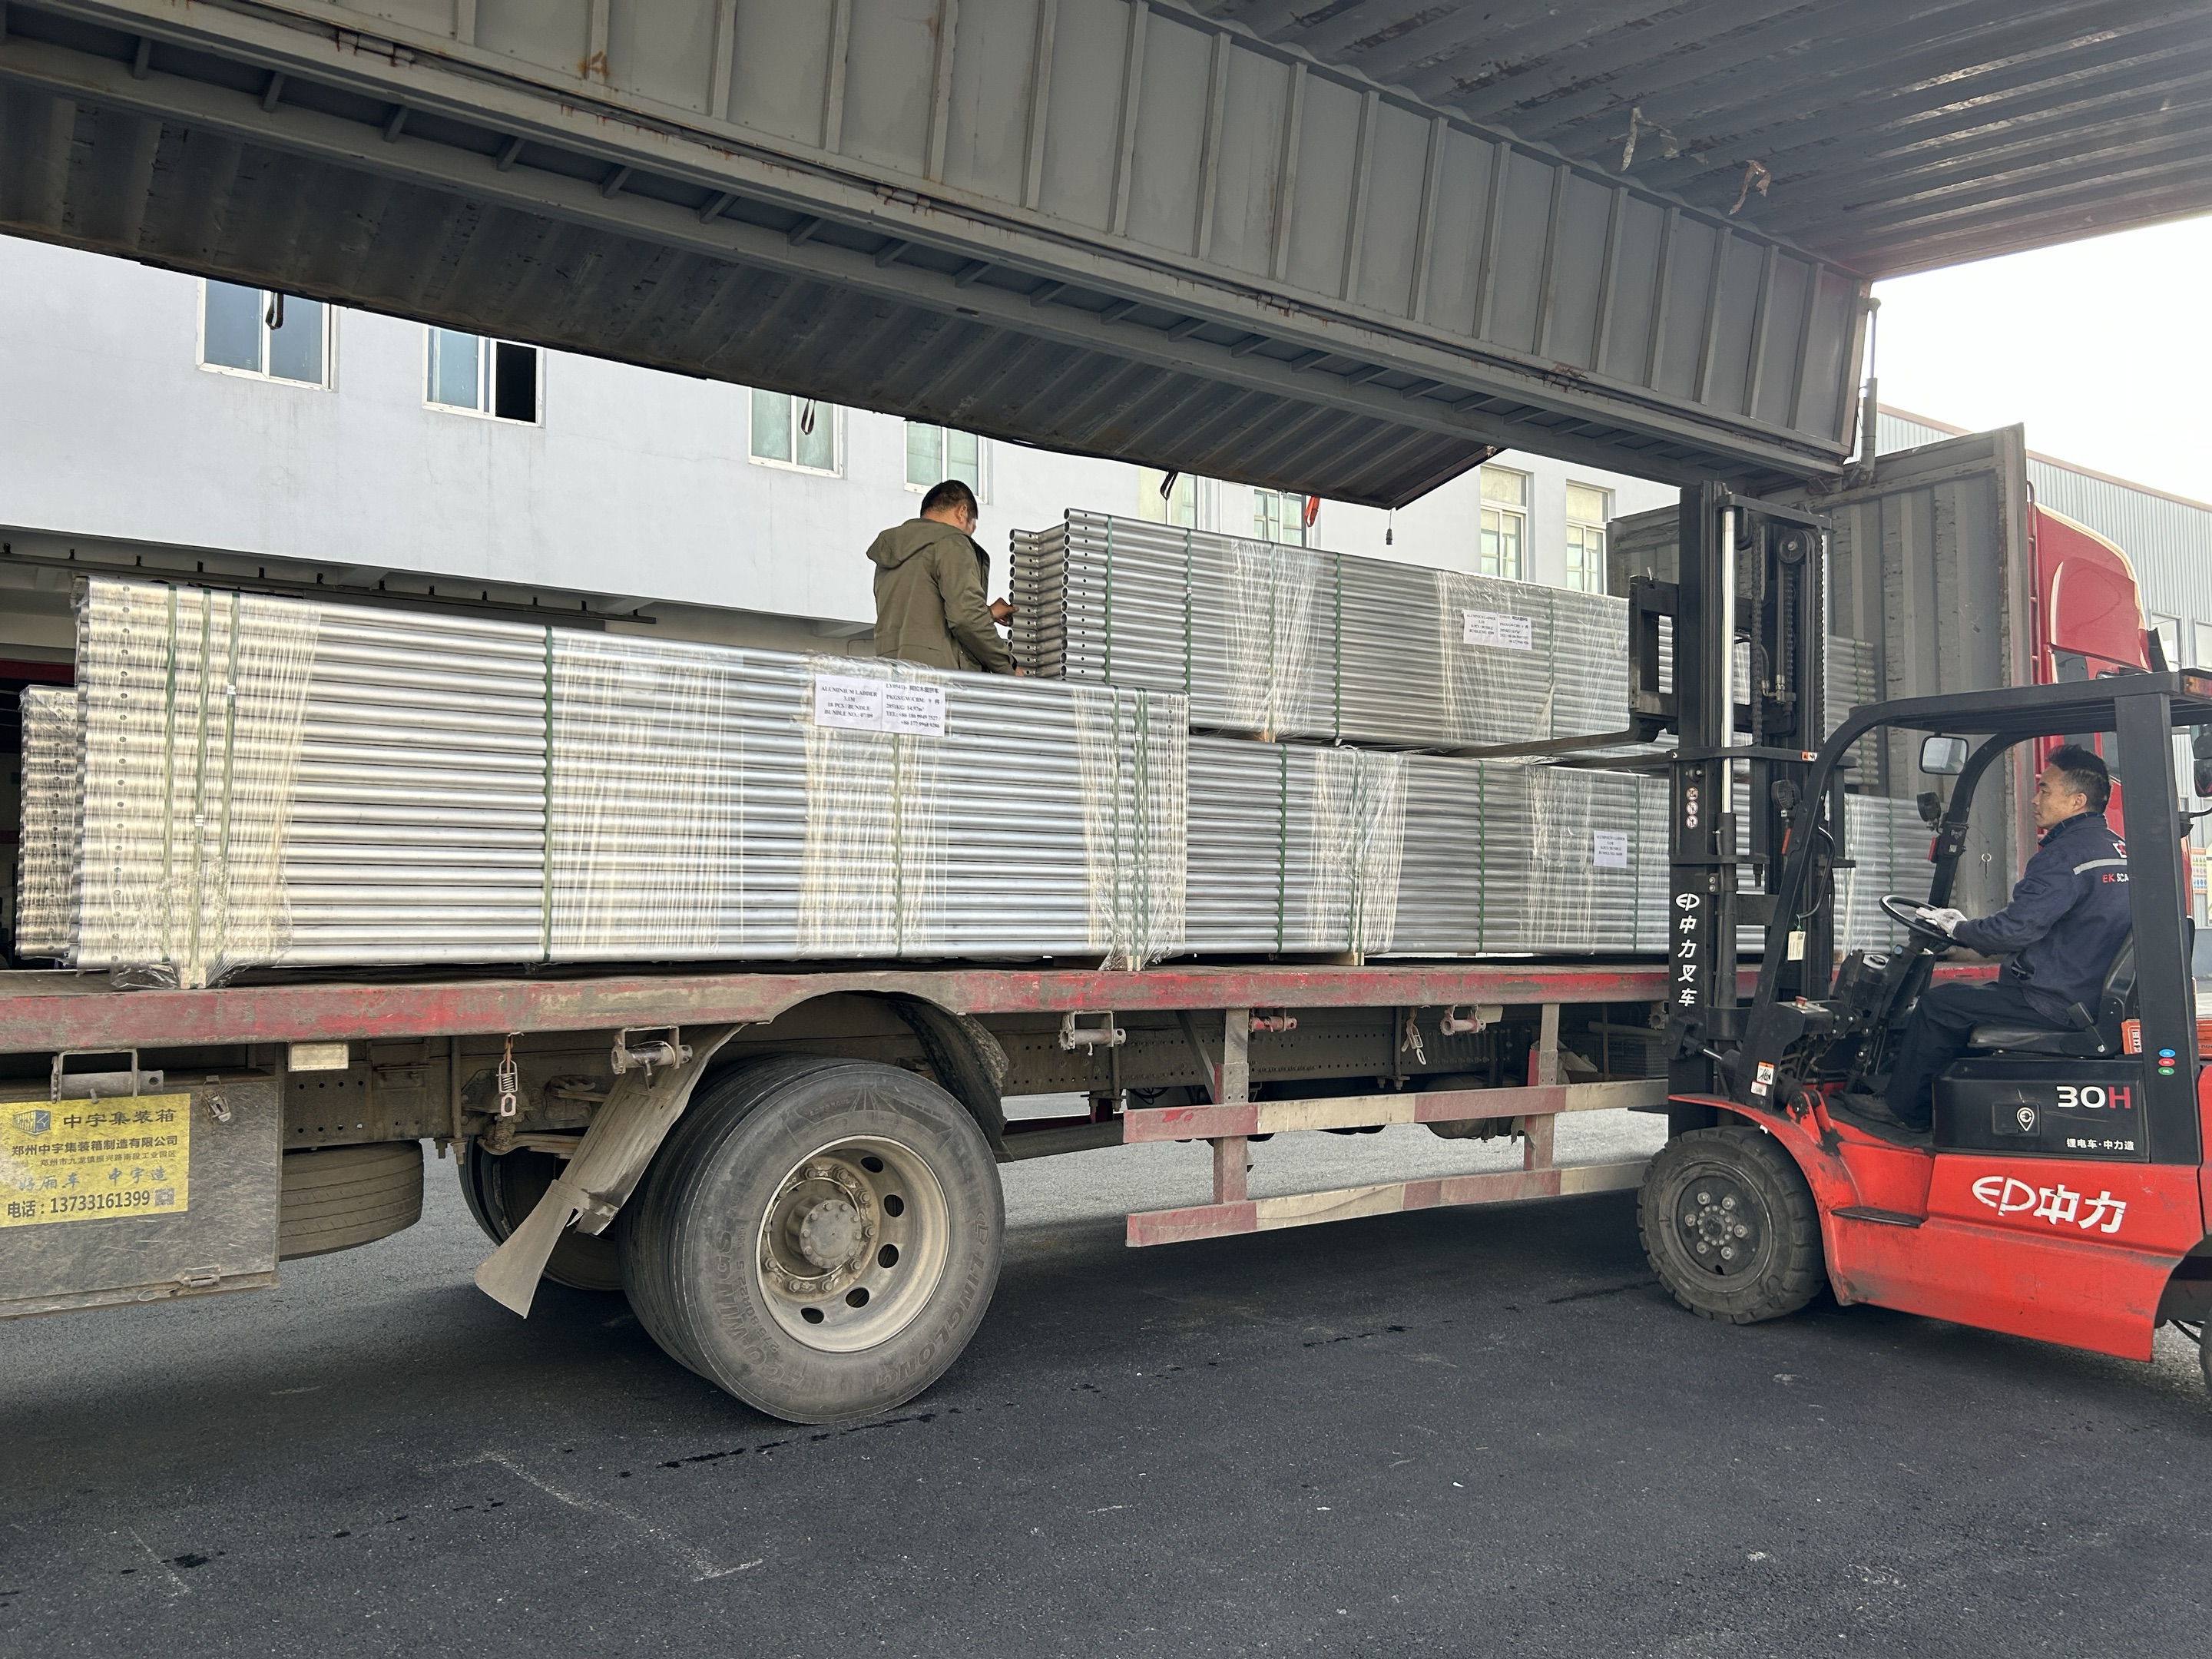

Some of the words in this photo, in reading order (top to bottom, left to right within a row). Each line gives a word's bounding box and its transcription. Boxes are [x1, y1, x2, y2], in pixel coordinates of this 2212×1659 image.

[2102, 873, 2115, 883] EK
[1677, 915, 1697, 1007] 中力叉车
[2056, 1085, 2131, 1109] 30H
[63, 1108, 177, 1129] 中宇集装箱
[12, 1135, 178, 1157] 郑州中宇集装箱制造有限公司
[878, 1253, 985, 1391] LINGLONG
